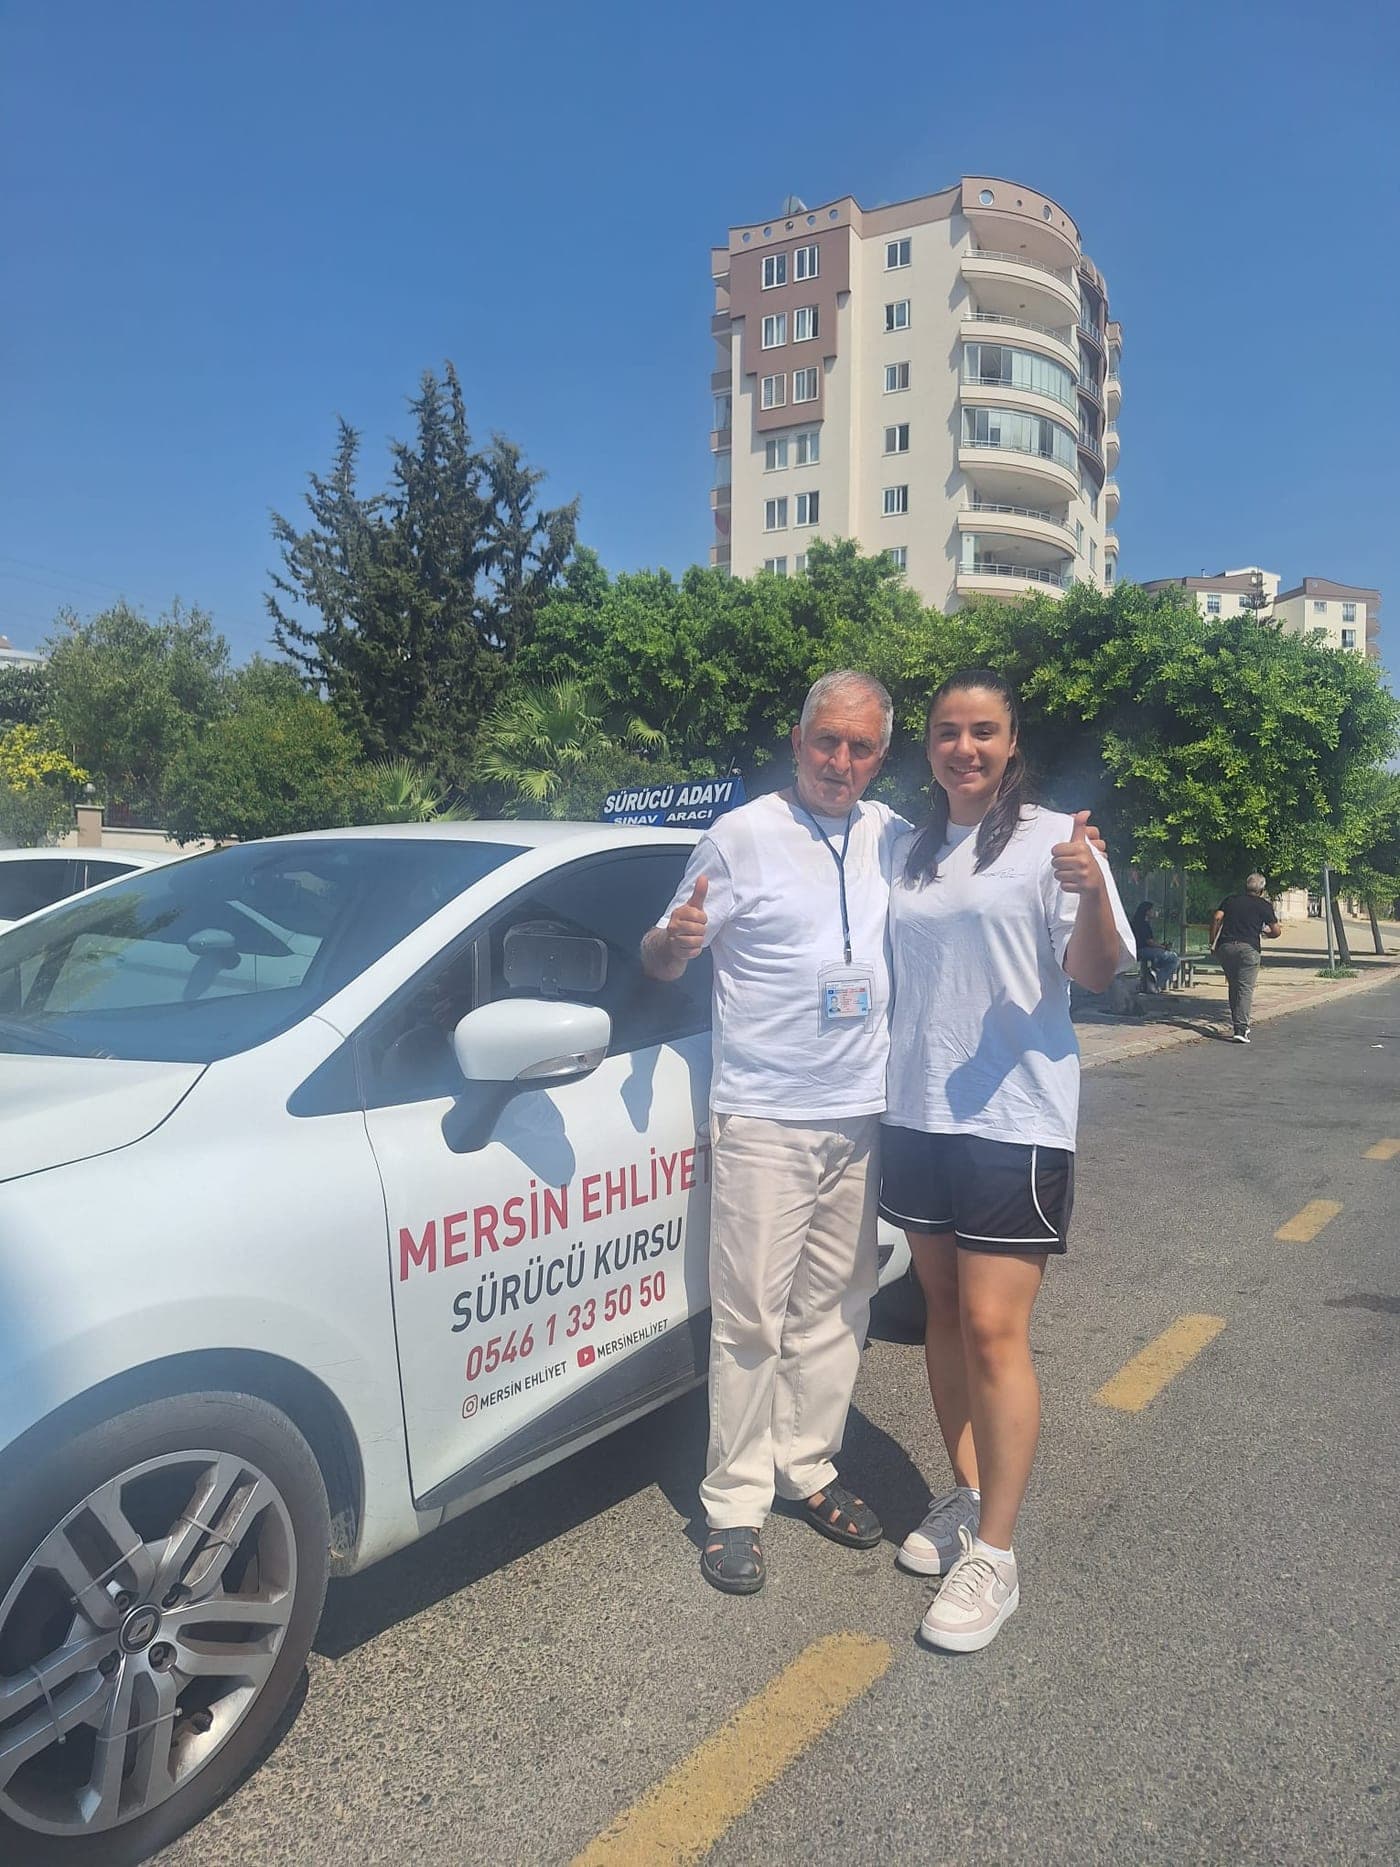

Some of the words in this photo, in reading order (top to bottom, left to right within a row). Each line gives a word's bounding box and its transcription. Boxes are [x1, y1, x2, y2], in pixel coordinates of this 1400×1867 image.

[604, 785, 674, 813] SÜRÜCÜ
[676, 782, 733, 807] ADAYI
[614, 815, 658, 825] SINAV
[666, 809, 713, 822] ARACI
[399, 1179, 568, 1281] MERSİN
[582, 1143, 711, 1223] EHLİYET
[451, 1241, 585, 1333] SÜRÜCÜ
[594, 1217, 682, 1279] KURSU
[466, 1323, 534, 1381] 0546
[547, 1313, 557, 1346] 1
[566, 1298, 596, 1337] 33
[604, 1284, 632, 1321] 50
[640, 1271, 666, 1307] 50
[480, 1381, 522, 1410] MERSİN
[525, 1361, 567, 1390] EHLİYET
